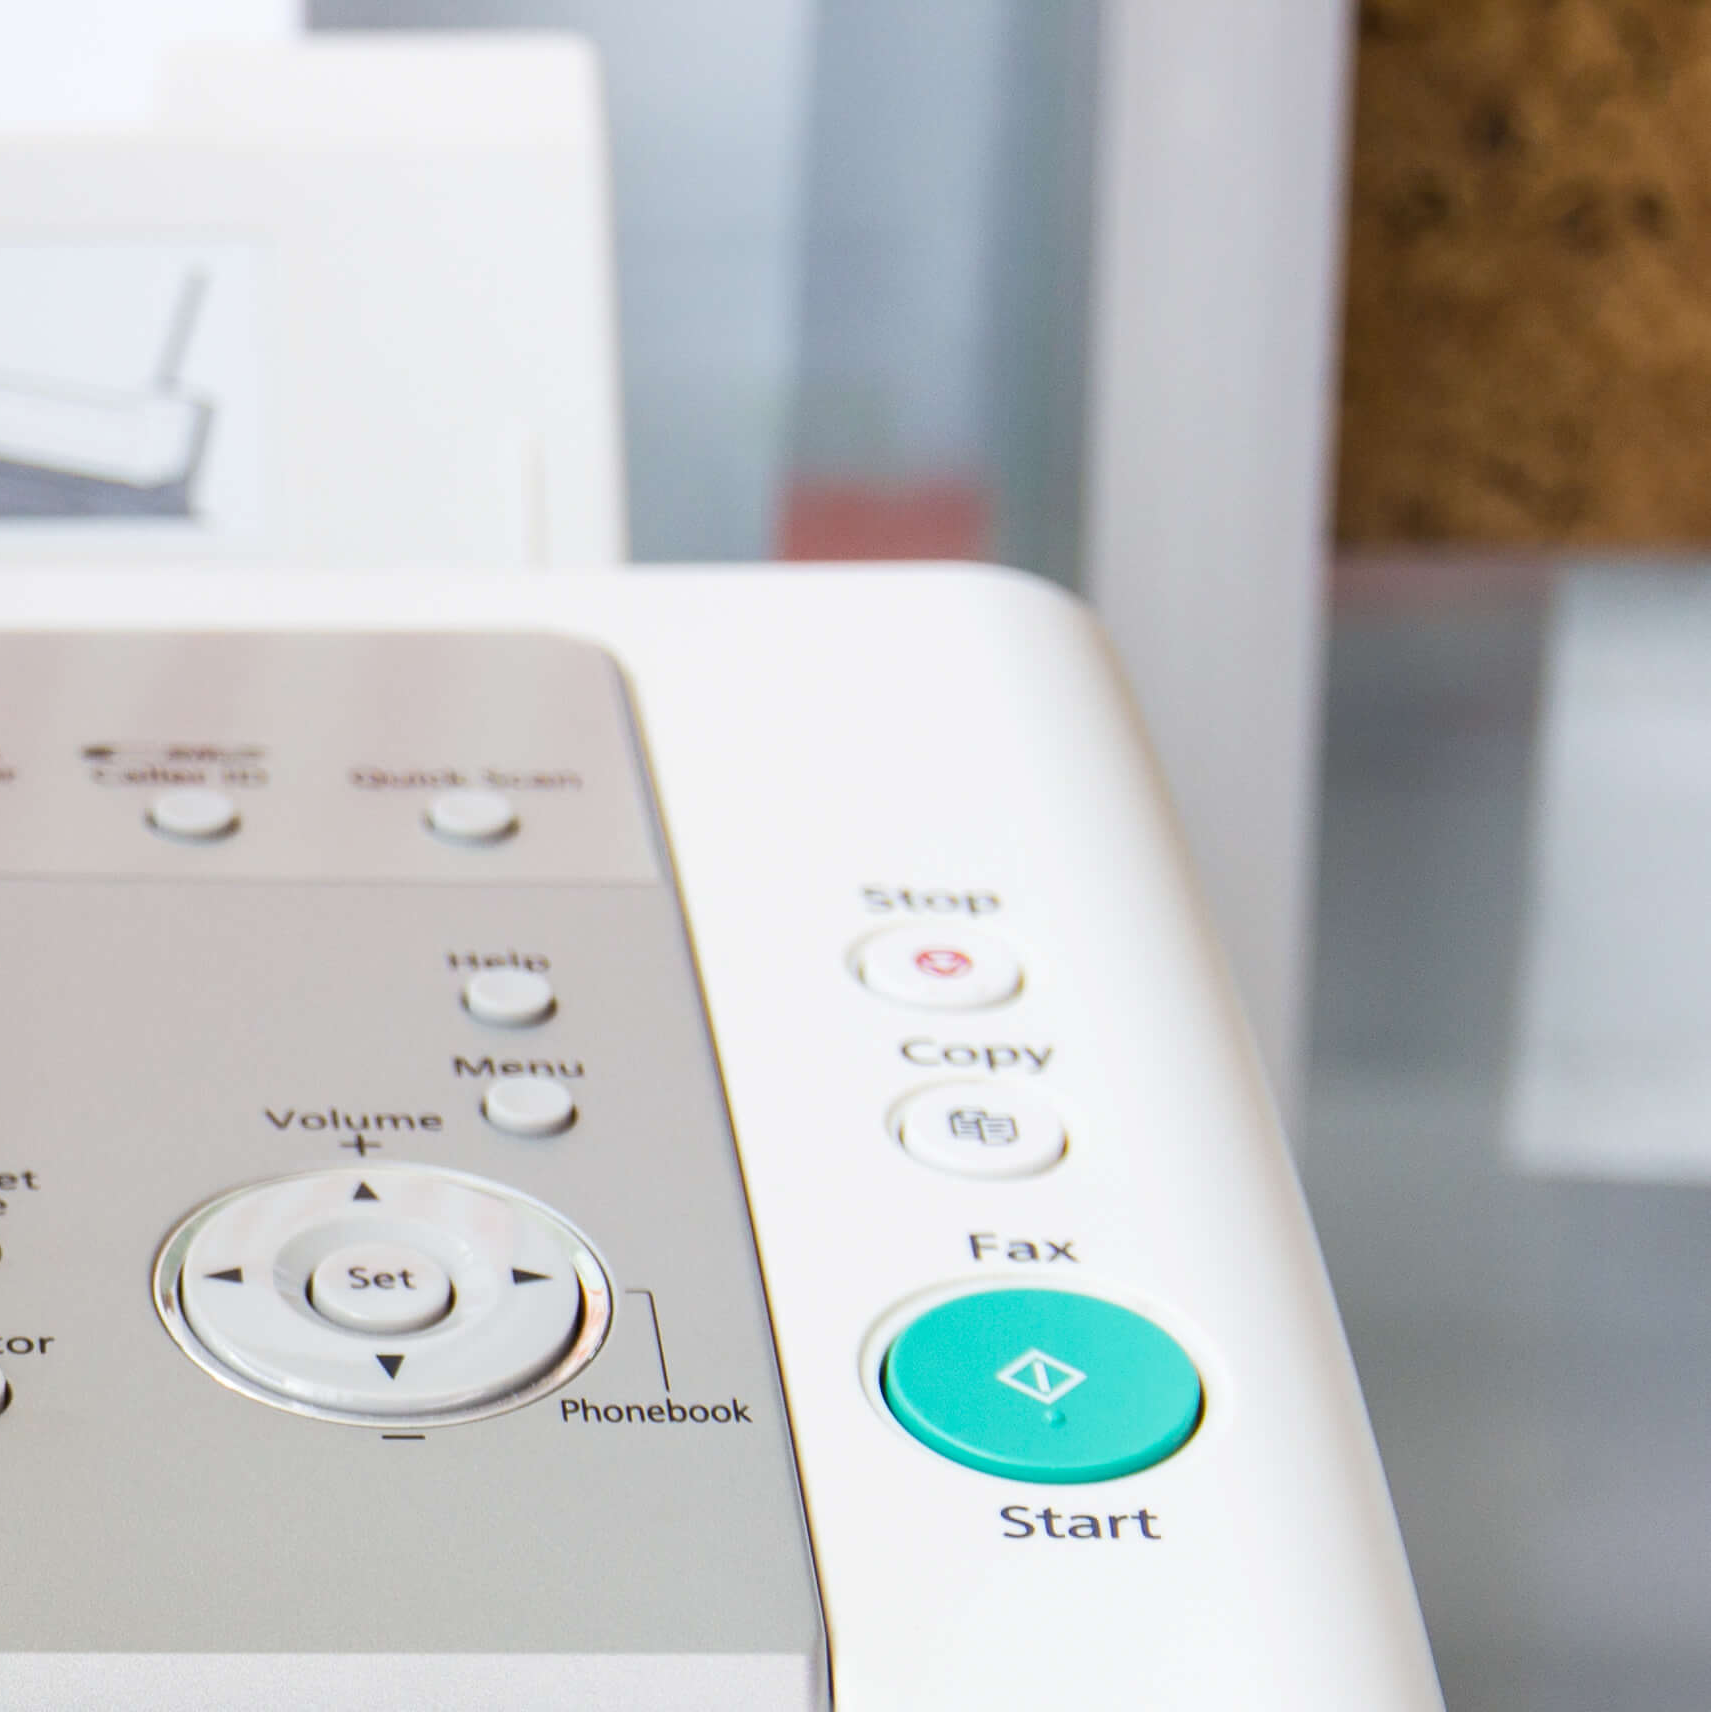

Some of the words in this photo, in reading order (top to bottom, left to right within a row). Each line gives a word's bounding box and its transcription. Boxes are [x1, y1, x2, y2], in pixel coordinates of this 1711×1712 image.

[862, 887, 1001, 917] Stop
[447, 952, 550, 972] Help
[452, 1056, 585, 1078] Menu
[899, 1042, 1053, 1072] Copy
[264, 1108, 443, 1132] Volume
[968, 1233, 1076, 1262] Fax
[347, 1266, 413, 1290] Set
[560, 1397, 752, 1424] Phonebook
[999, 1505, 1161, 1540] Start
